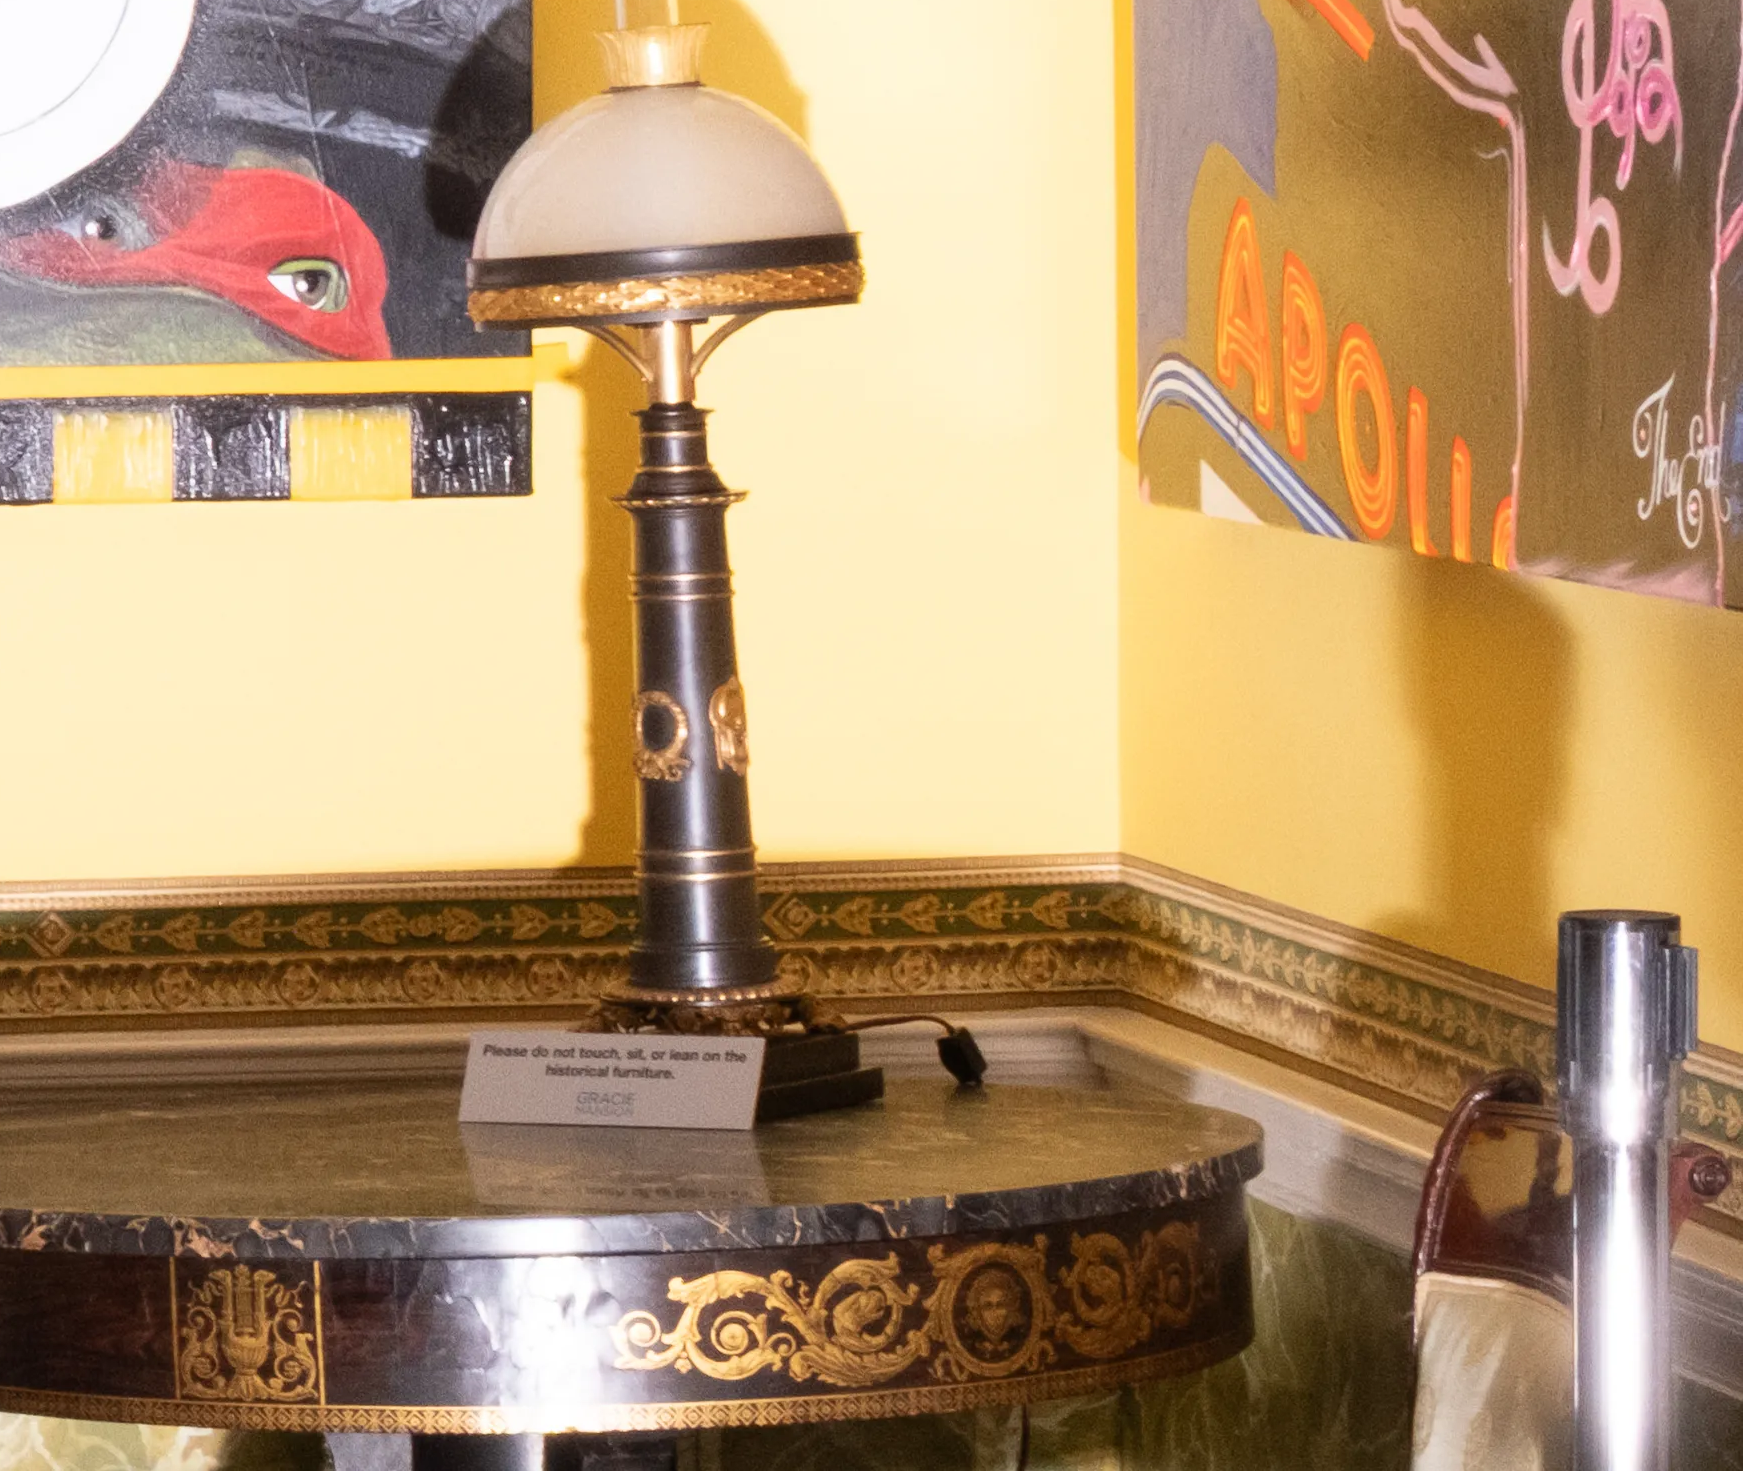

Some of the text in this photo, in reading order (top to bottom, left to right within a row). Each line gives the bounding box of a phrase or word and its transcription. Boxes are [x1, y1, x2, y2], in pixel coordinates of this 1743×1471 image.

[1632, 370, 1731, 549] The End
[483, 1044, 528, 1058] Please
[532, 1045, 548, 1058] do
[552, 1046, 575, 1058] not
[578, 1046, 621, 1060] touch,
[651, 1050, 665, 1060] or
[670, 1049, 699, 1061] lean
[702, 1052, 720, 1062] on
[725, 1050, 747, 1063] the
[545, 1065, 675, 1079] historical furniture.
